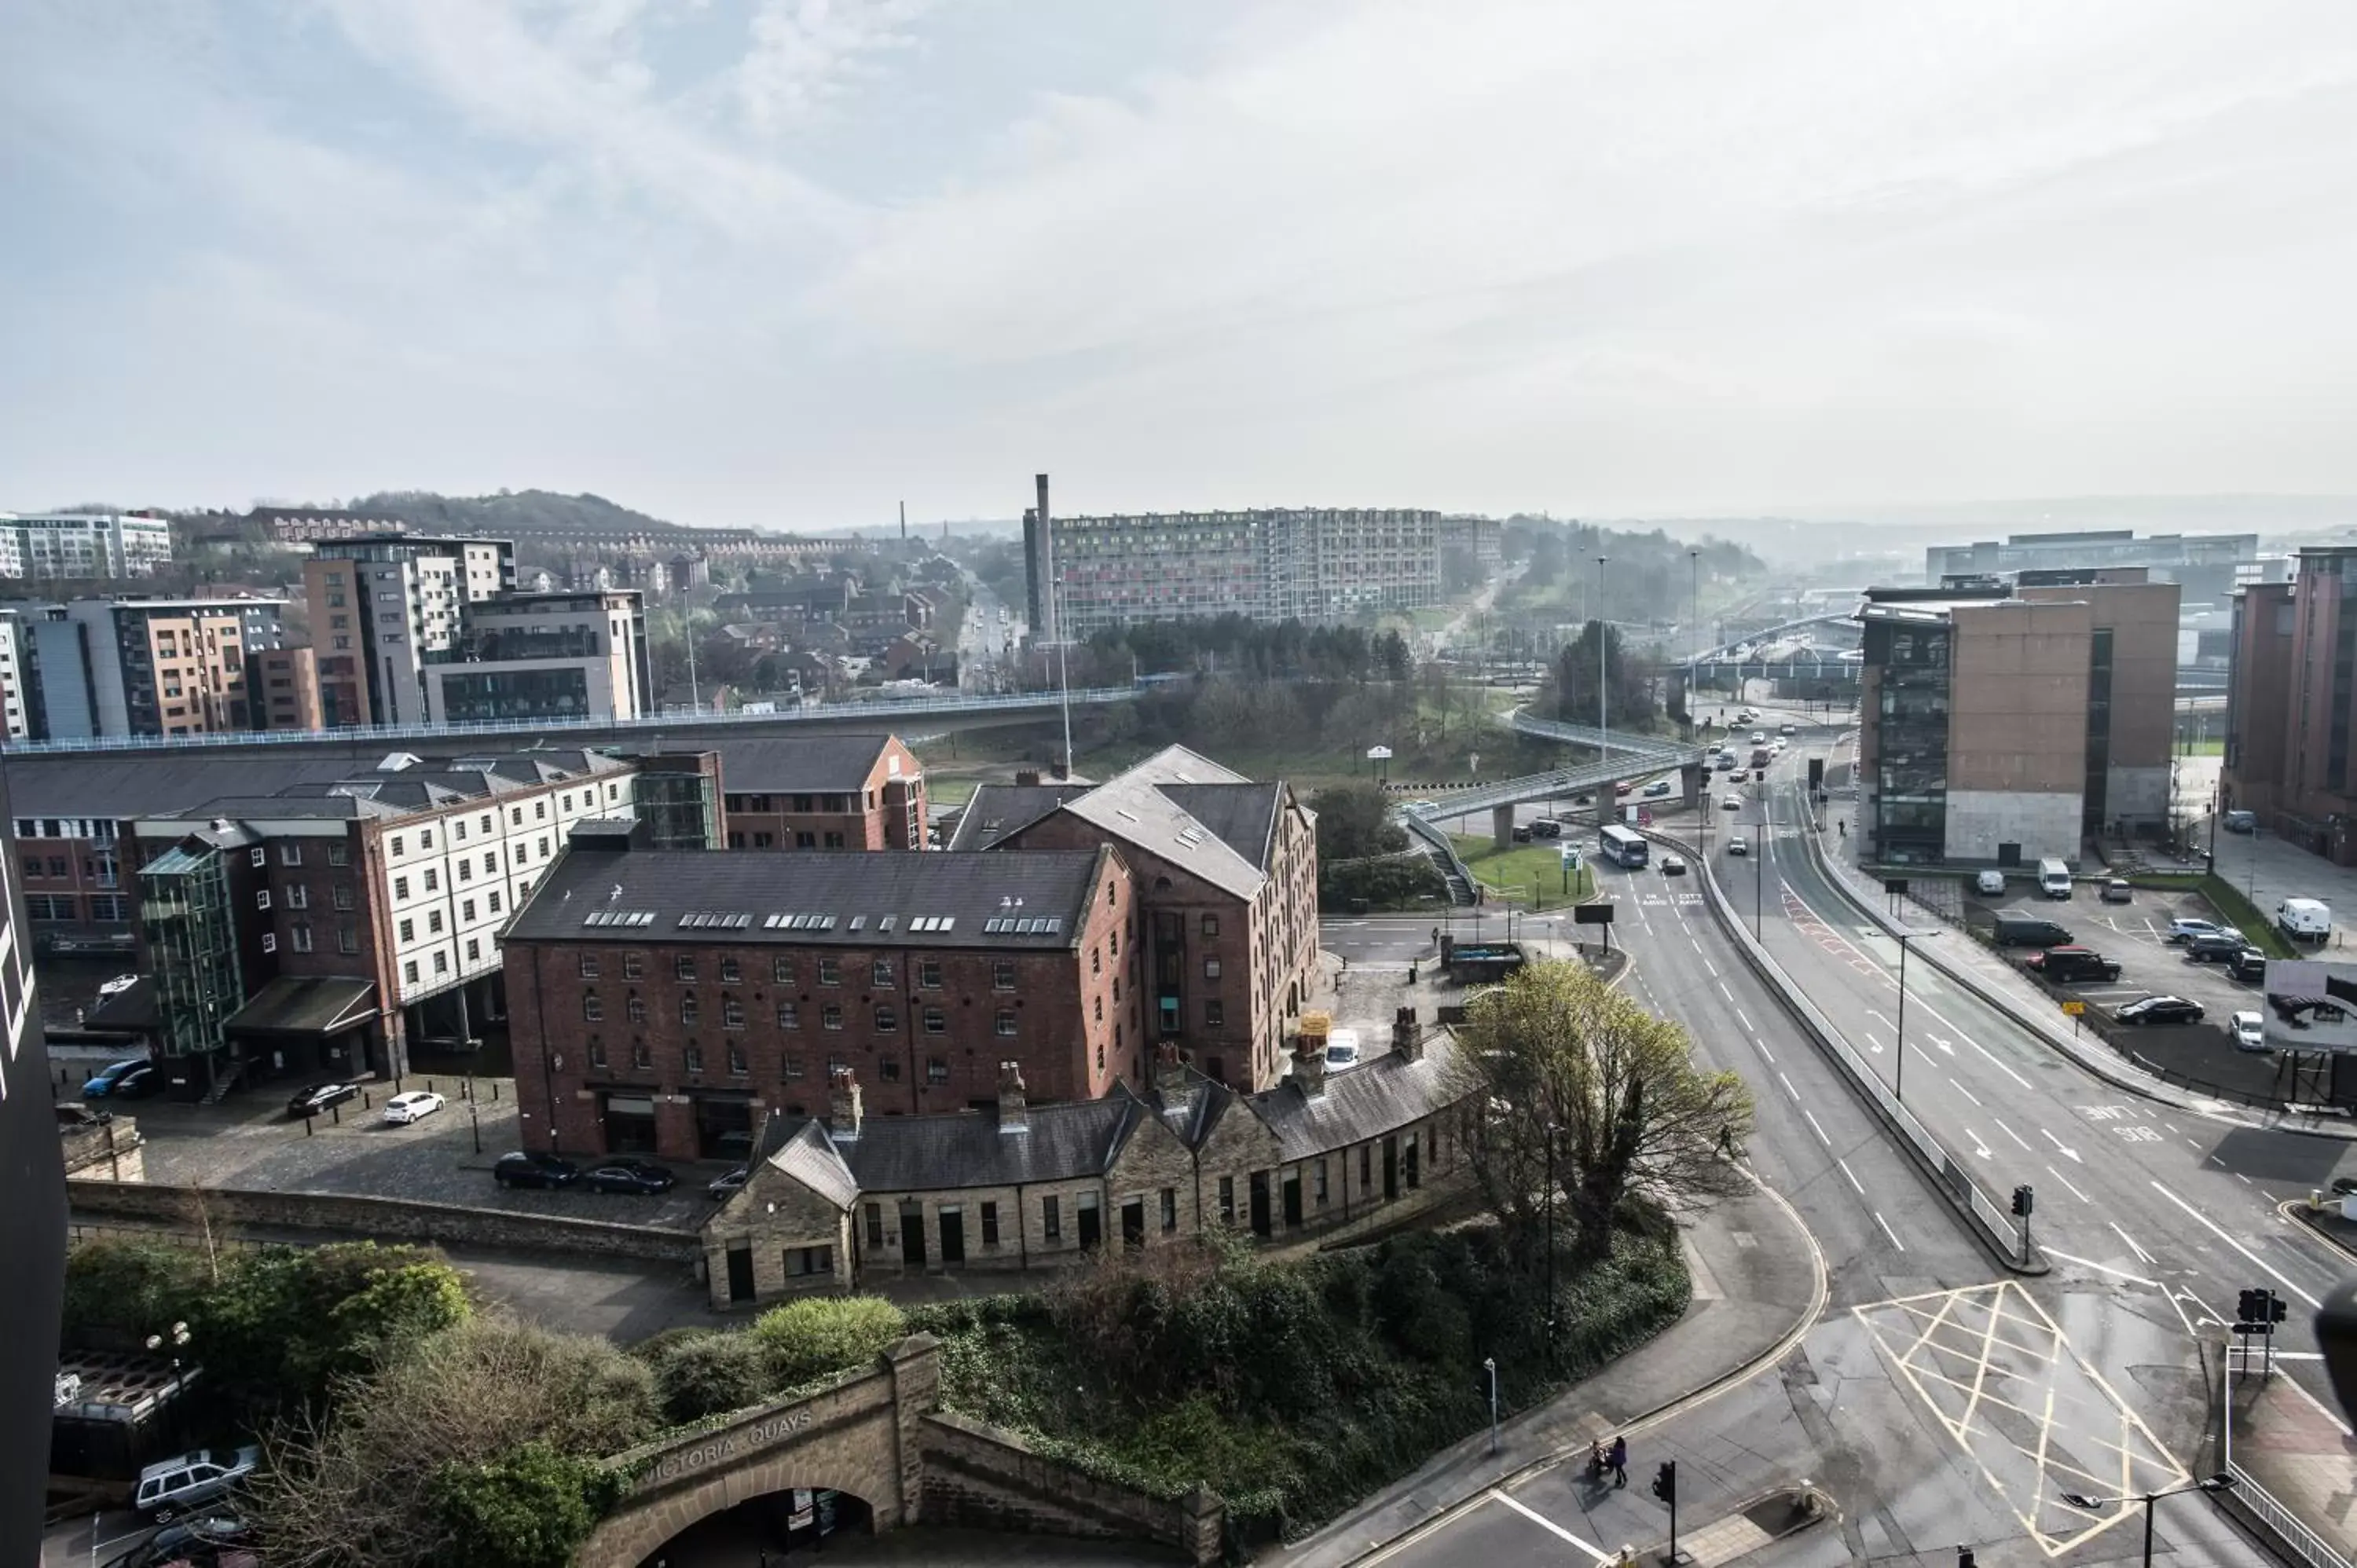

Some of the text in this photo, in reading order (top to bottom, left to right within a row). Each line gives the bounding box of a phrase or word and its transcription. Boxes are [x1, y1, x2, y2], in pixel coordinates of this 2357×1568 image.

[2113, 1126, 2163, 1142] BUS
[644, 1411, 812, 1483] VICTORIA QUAYS
